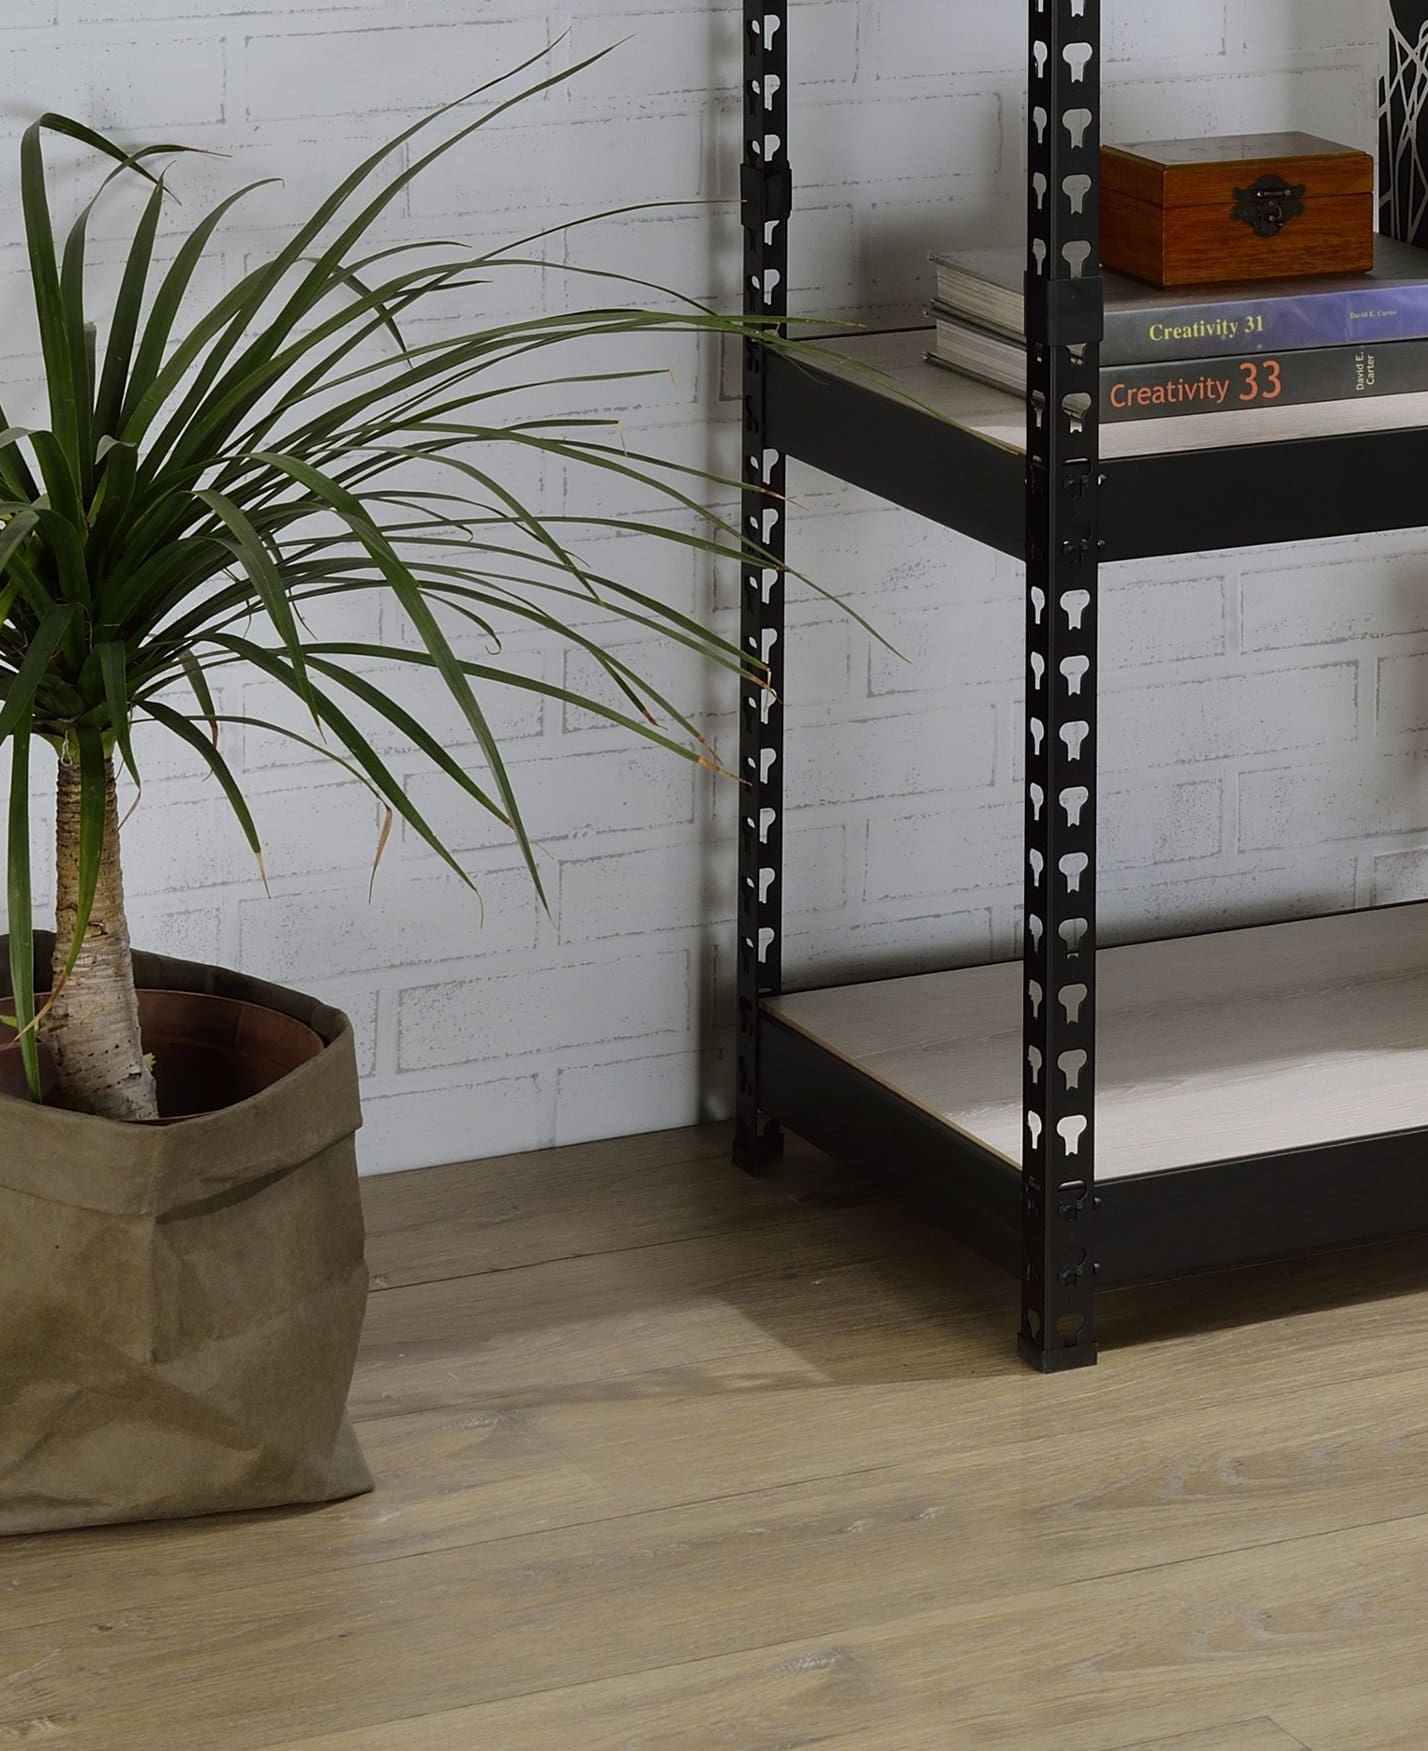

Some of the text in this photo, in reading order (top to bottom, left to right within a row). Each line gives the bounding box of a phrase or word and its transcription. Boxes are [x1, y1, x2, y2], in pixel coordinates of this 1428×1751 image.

[1149, 315, 1265, 342] Creativity 31
[1349, 310, 1369, 320] David
[1109, 359, 1282, 408] Creativity 33
[1355, 350, 1365, 391] David E.
[1366, 354, 1375, 386] Carter
